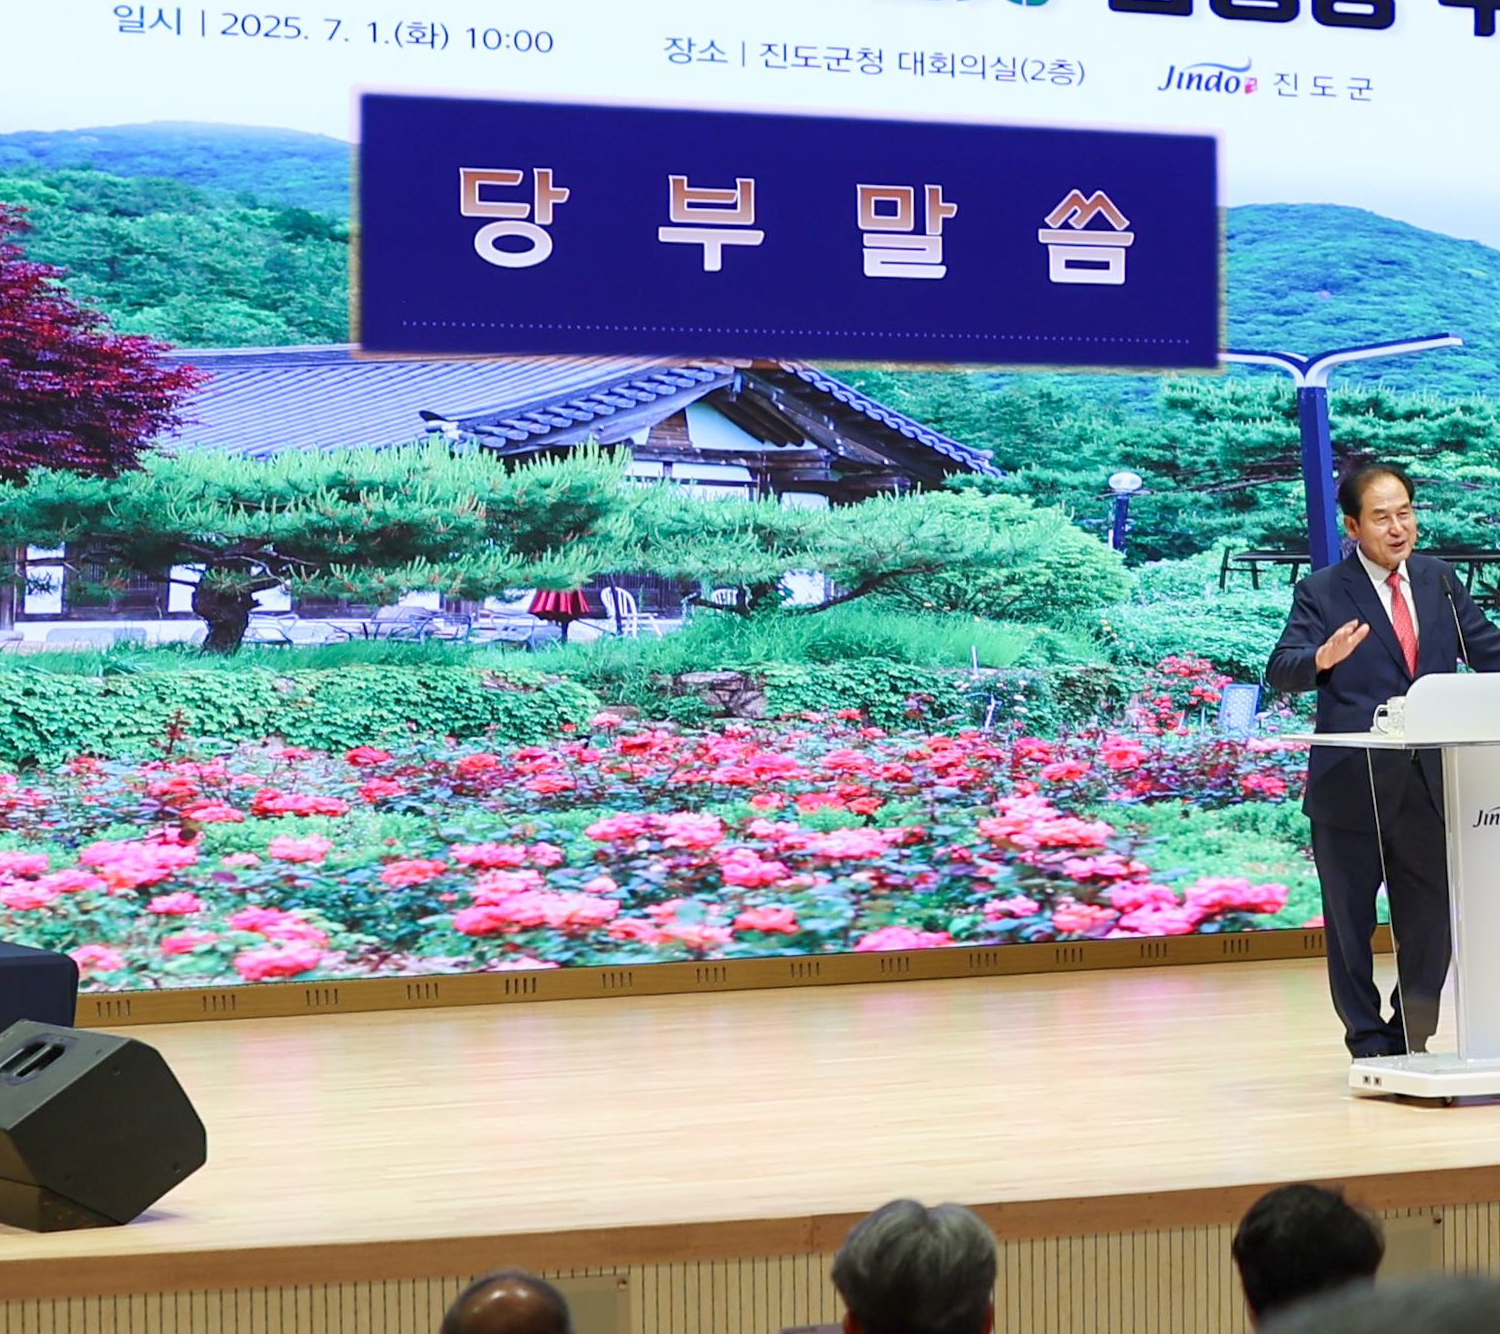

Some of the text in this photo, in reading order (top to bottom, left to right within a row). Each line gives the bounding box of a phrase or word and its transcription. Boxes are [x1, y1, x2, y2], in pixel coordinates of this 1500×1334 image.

[113, 4, 182, 35] 일시
[220, 12, 309, 40] 2025.
[323, 18, 349, 42] 7.
[465, 26, 554, 53] 10:00
[663, 37, 729, 65] 장소
[759, 43, 884, 75] 진도군청
[898, 51, 1086, 86] 대회의실(2층)
[1157, 65, 1241, 94] Jindo
